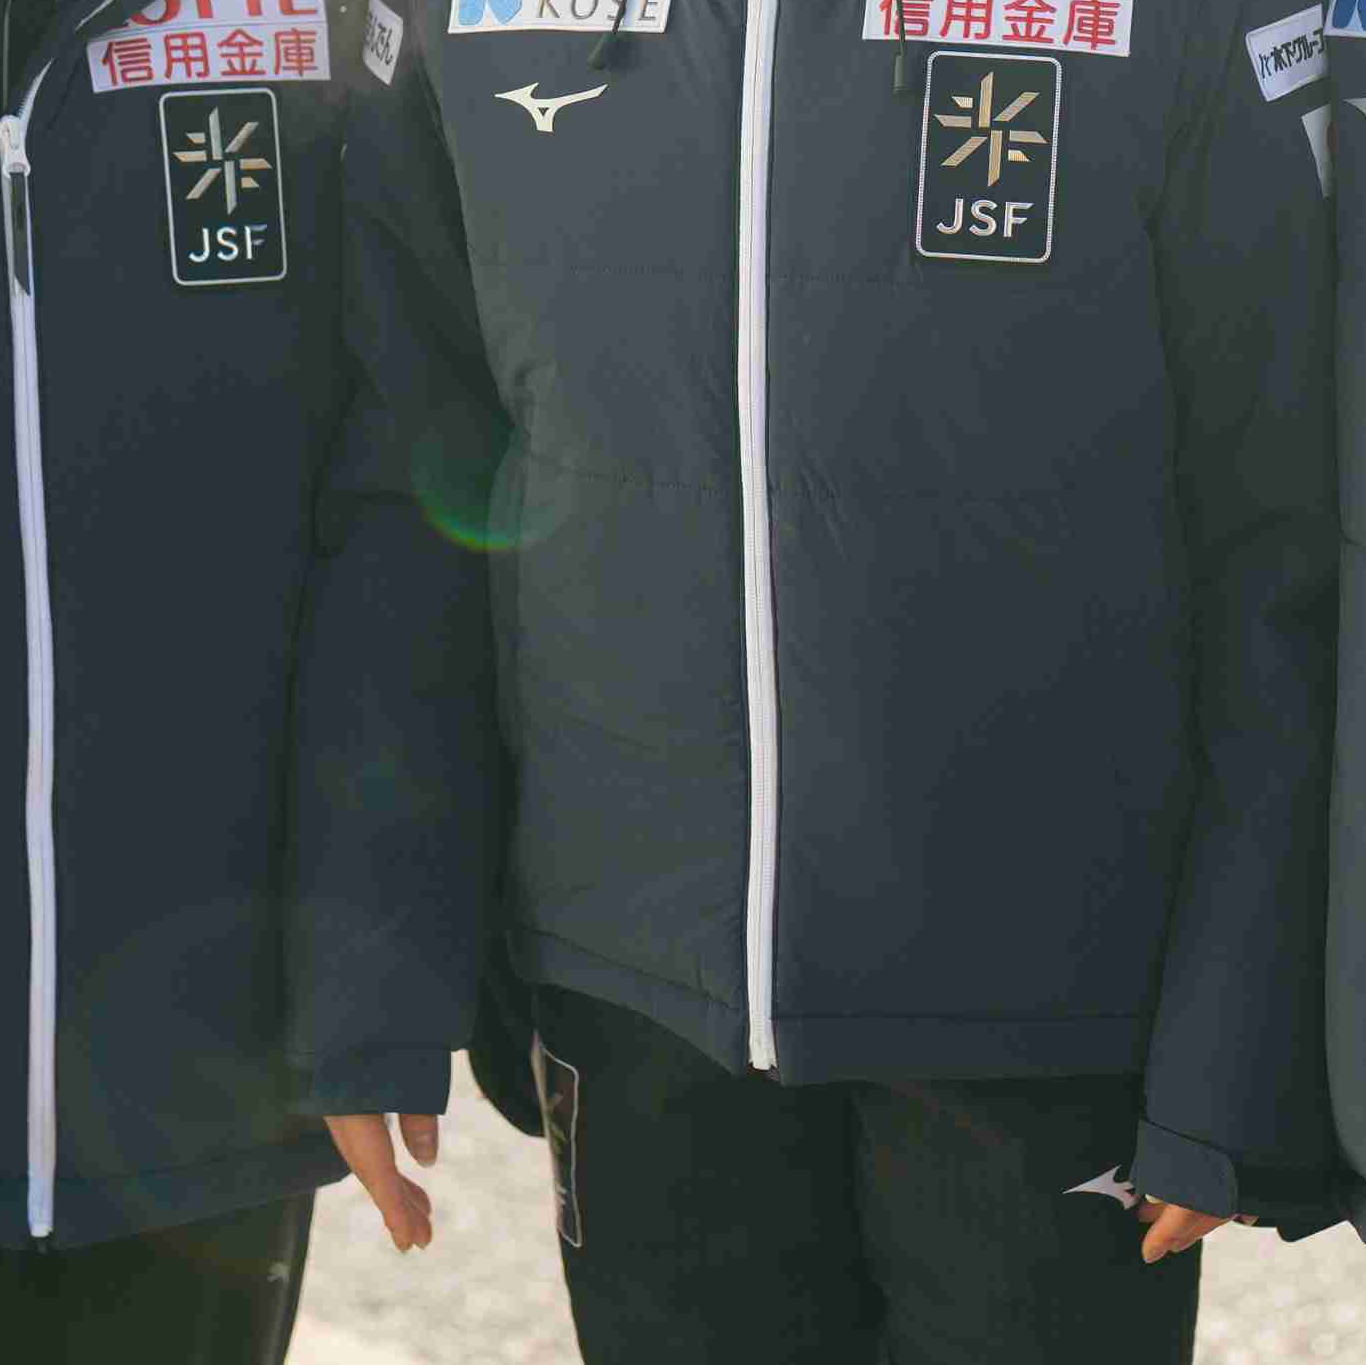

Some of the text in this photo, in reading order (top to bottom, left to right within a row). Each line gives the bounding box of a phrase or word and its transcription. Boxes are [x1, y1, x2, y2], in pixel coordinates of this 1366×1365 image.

[102, 28, 319, 86] 信用金庫
[935, 198, 1035, 238] JSF
[189, 224, 268, 263] JSF
